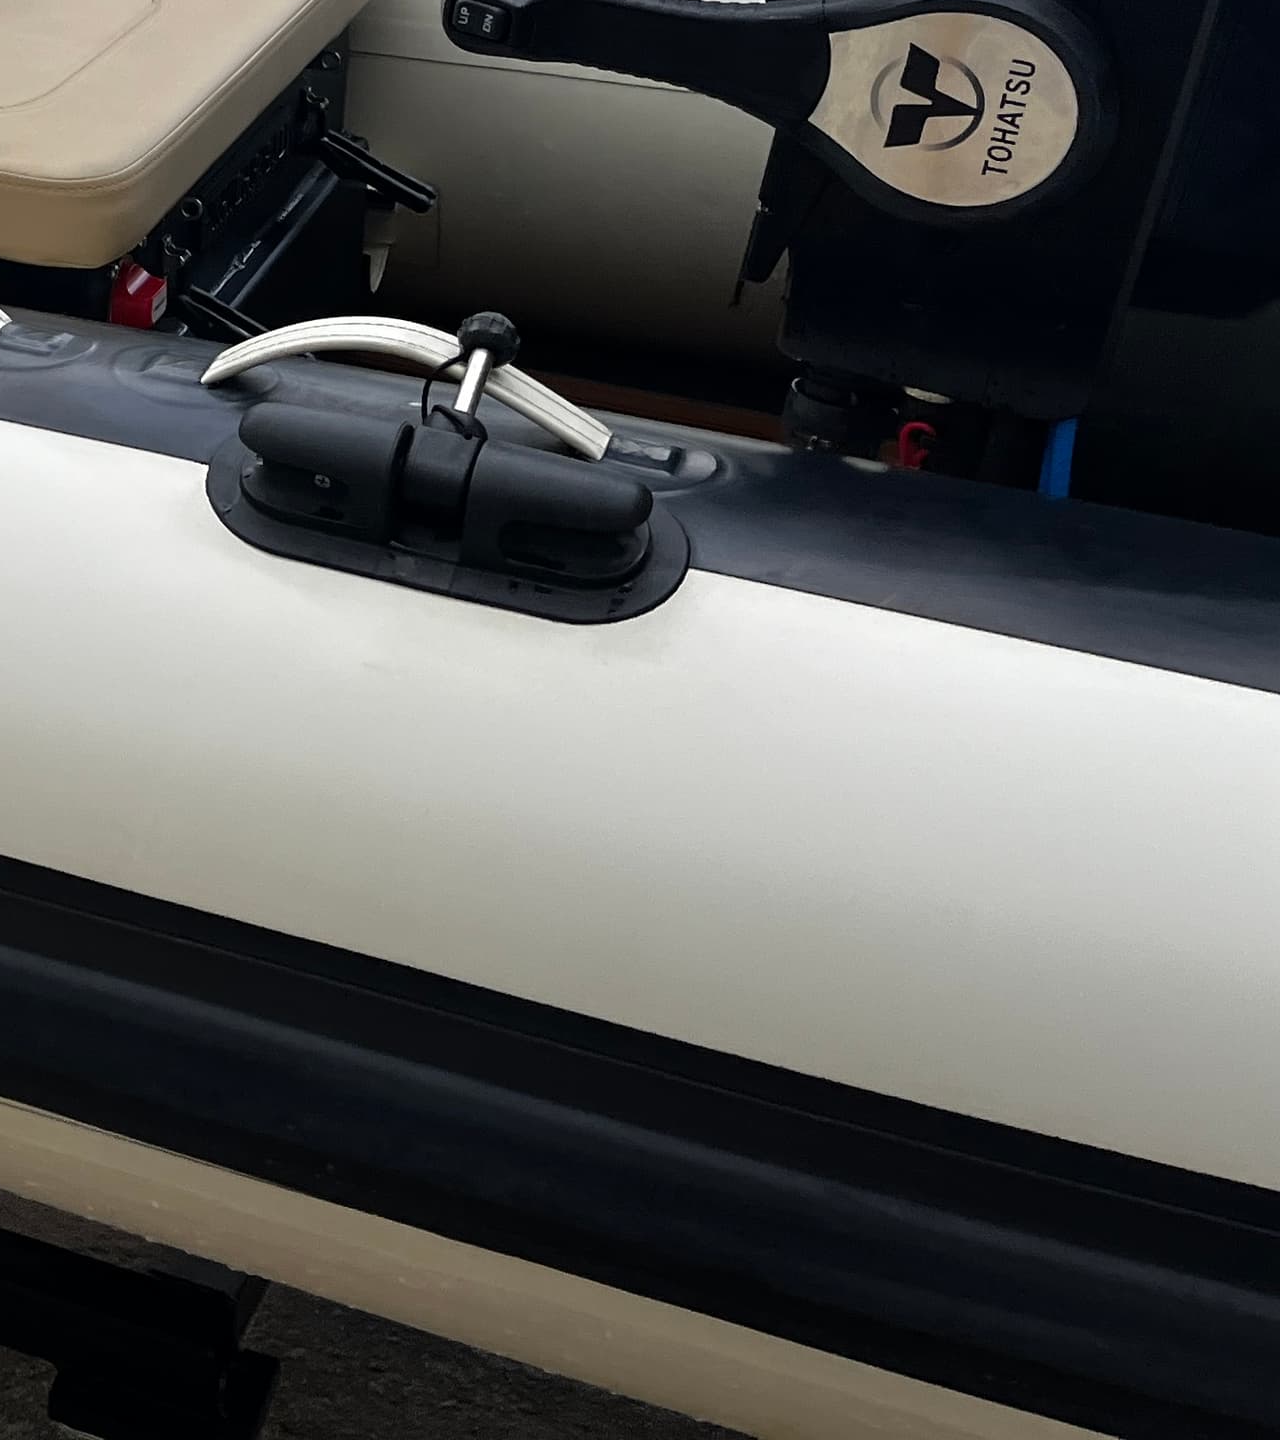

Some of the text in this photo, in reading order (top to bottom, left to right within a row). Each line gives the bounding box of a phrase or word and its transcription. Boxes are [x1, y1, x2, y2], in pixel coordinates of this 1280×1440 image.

[458, 6, 470, 25] UP
[482, 13, 494, 33] DN
[981, 58, 1036, 176] TOHATSU
